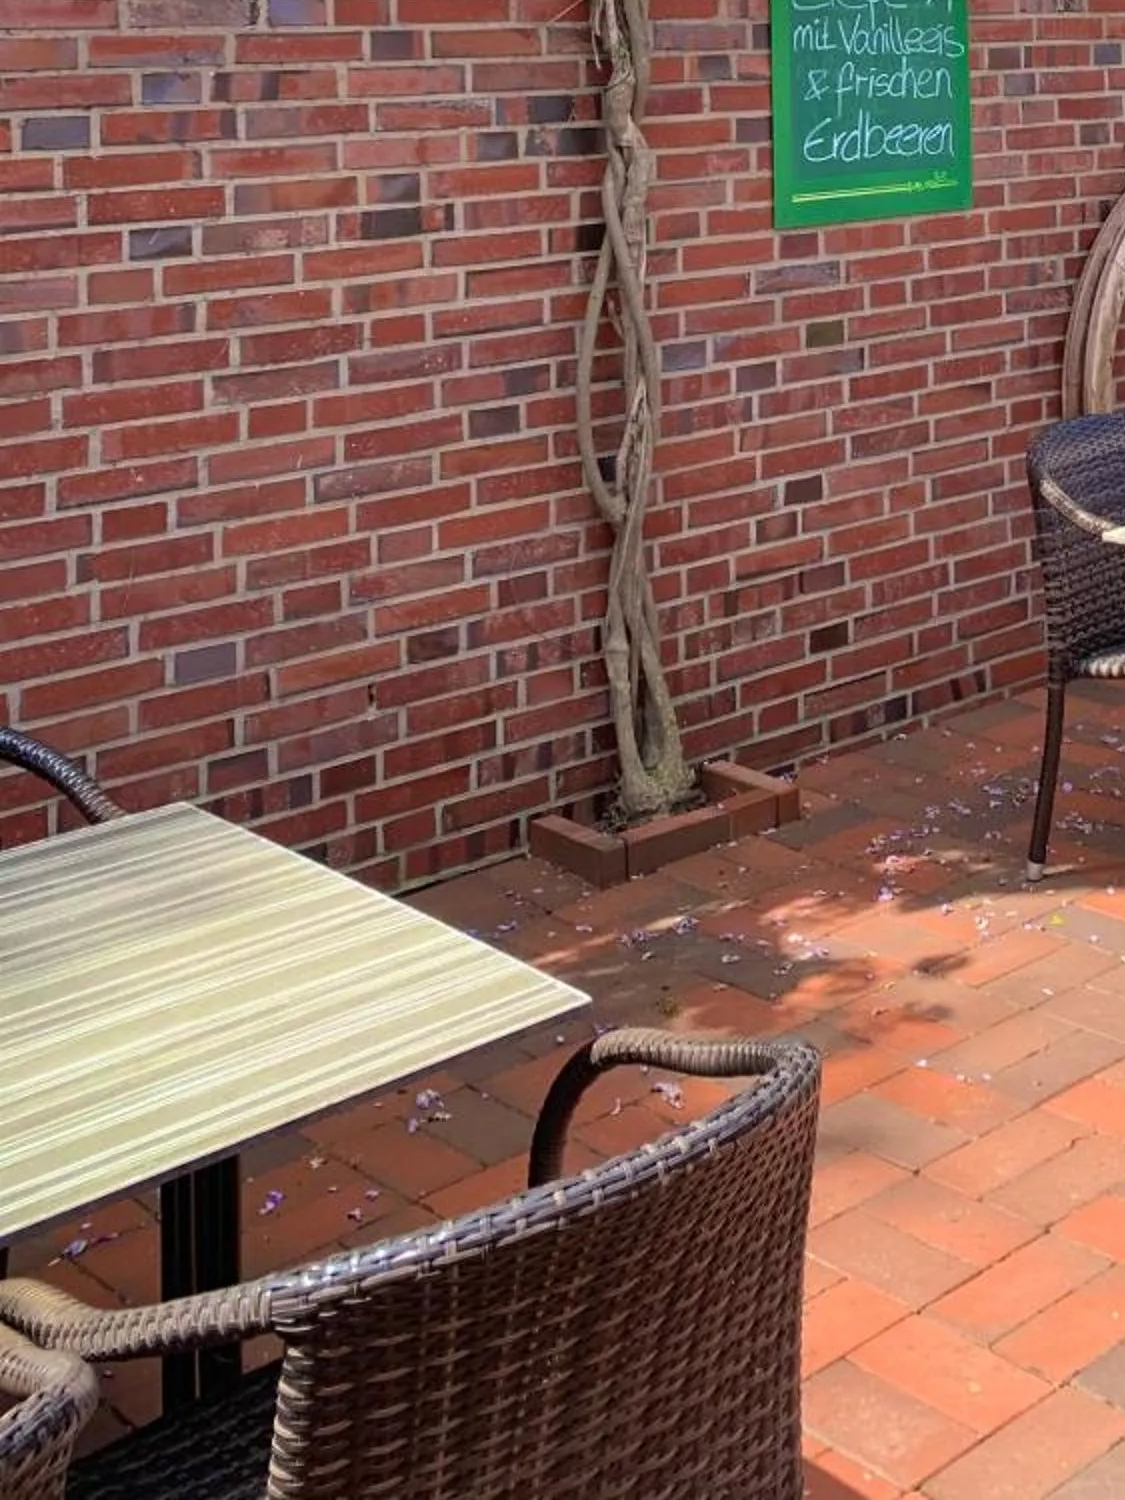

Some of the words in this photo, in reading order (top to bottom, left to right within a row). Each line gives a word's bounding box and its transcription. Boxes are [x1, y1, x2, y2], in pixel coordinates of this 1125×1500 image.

[793, 16, 837, 51] mit
[837, 12, 965, 57] Vanilleeis
[803, 68, 830, 101] &
[835, 55, 953, 118] frischen
[803, 107, 955, 162] Erdbeeren
